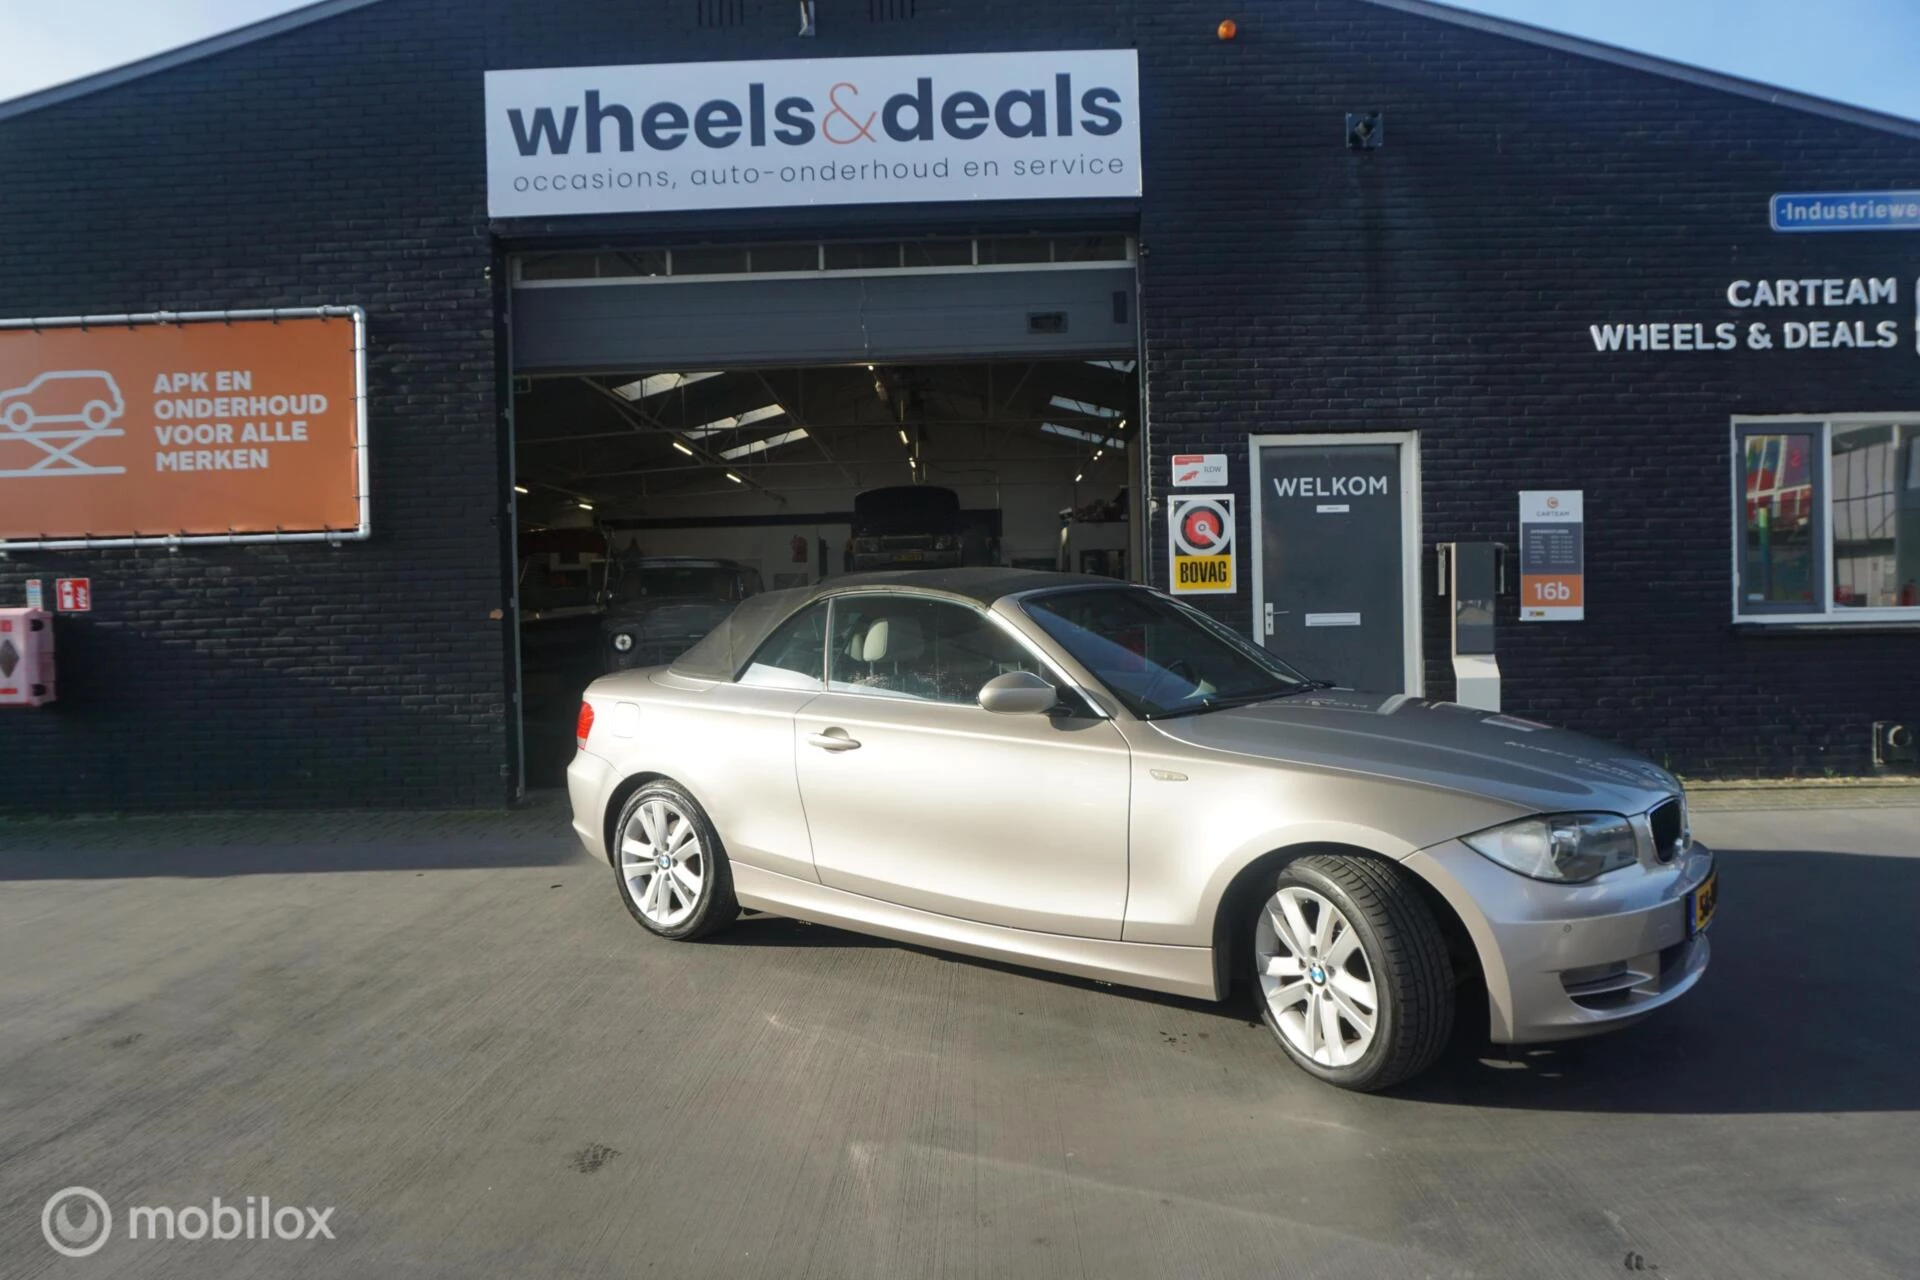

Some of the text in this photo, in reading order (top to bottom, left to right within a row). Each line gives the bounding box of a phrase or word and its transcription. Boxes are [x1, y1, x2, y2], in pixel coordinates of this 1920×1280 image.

[506, 73, 1124, 157] wheels&deals
[513, 153, 1124, 193] occasions, auto-onderhoud en service
[1787, 200, 1920, 221] Industriewe
[1726, 277, 1897, 307] CARTEAM
[1589, 320, 1898, 352] WHEELS & DEALS
[154, 370, 252, 394] APK EN
[154, 393, 328, 420] ONDERHOUD
[154, 421, 308, 446] VOOR ALLE
[156, 449, 269, 472] MERKEN
[1273, 475, 1388, 497] WELKOM
[1179, 560, 1228, 584] BOVAG
[1534, 581, 1571, 601] 16b
